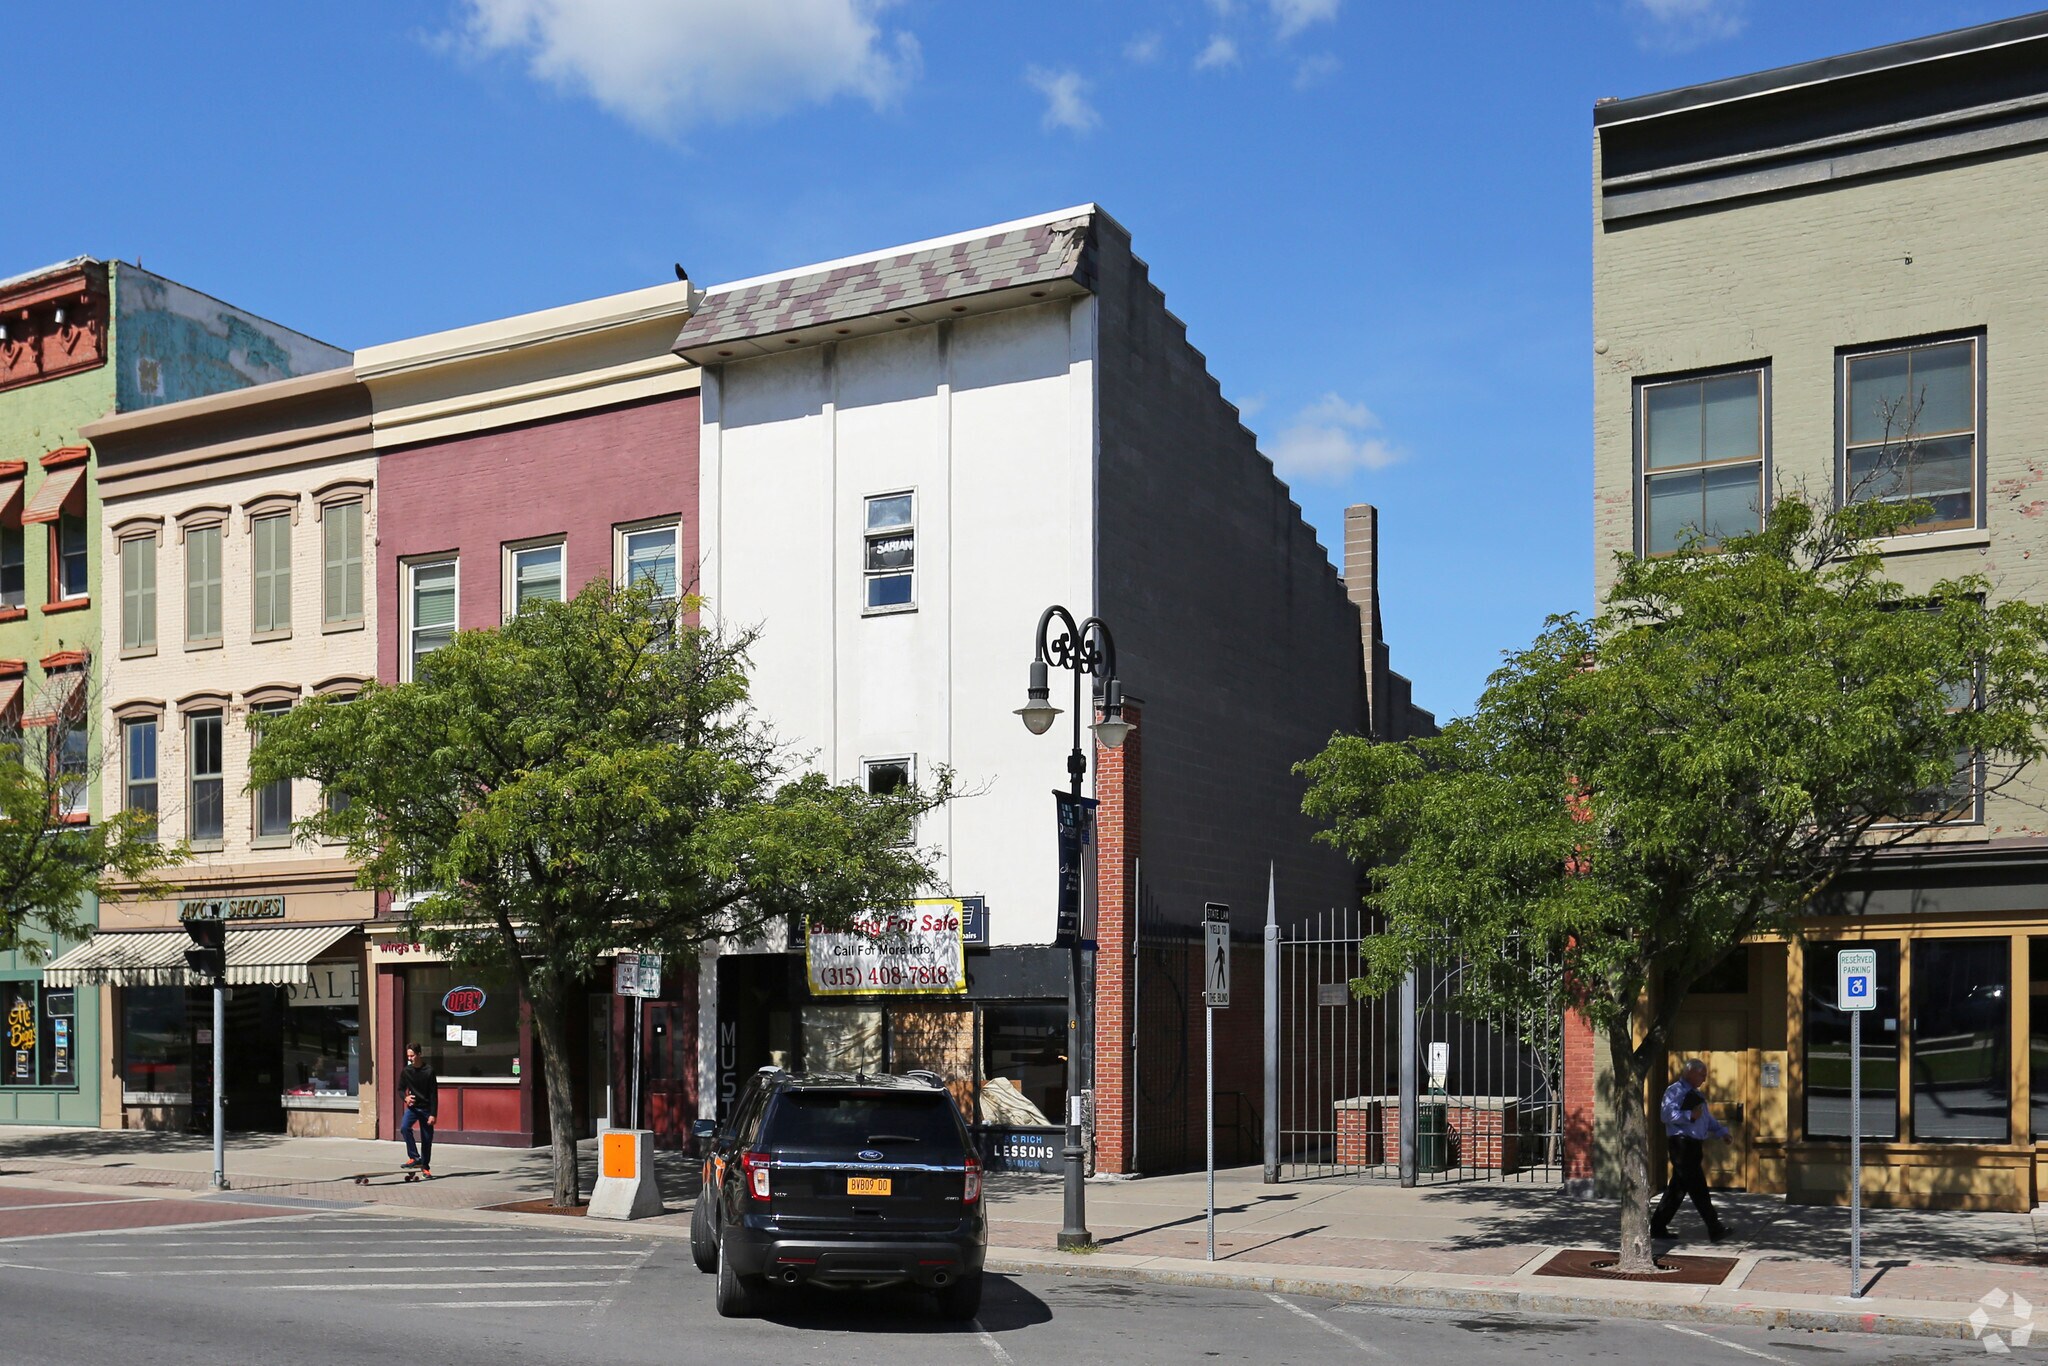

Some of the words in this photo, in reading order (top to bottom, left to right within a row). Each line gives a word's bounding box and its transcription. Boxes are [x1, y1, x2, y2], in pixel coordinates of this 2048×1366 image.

[876, 539, 914, 555] SABIAN
[229, 899, 281, 918] SHOES
[1207, 908, 1220, 919] STATE
[1220, 910, 1229, 920] LAW
[811, 915, 880, 938] Bing
[886, 915, 917, 932] For
[921, 914, 959, 932] Sale
[1209, 924, 1220, 934] YIELD
[1221, 926, 1227, 935] TO
[379, 941, 409, 955] wings
[413, 942, 421, 953] &
[834, 945, 854, 957] Call
[858, 945, 875, 956] For
[880, 945, 906, 956] More
[909, 944, 934, 956] Info.
[640, 955, 646, 967] 2
[1841, 955, 1873, 964] RESERVED
[1843, 965, 1871, 974] PARKING
[821, 966, 862, 987] (315)
[868, 966, 949, 985] 408-7818
[287, 970, 359, 1000] SALE
[447, 991, 482, 1012] OPEN
[1209, 993, 1217, 1002] THE
[1217, 993, 1228, 1002] BLIND
[721, 1021, 736, 1123] MUSI
[1020, 1135, 1042, 1144] RICH
[994, 1144, 1054, 1159] LESSONS
[851, 1179, 874, 1190] BVB09
